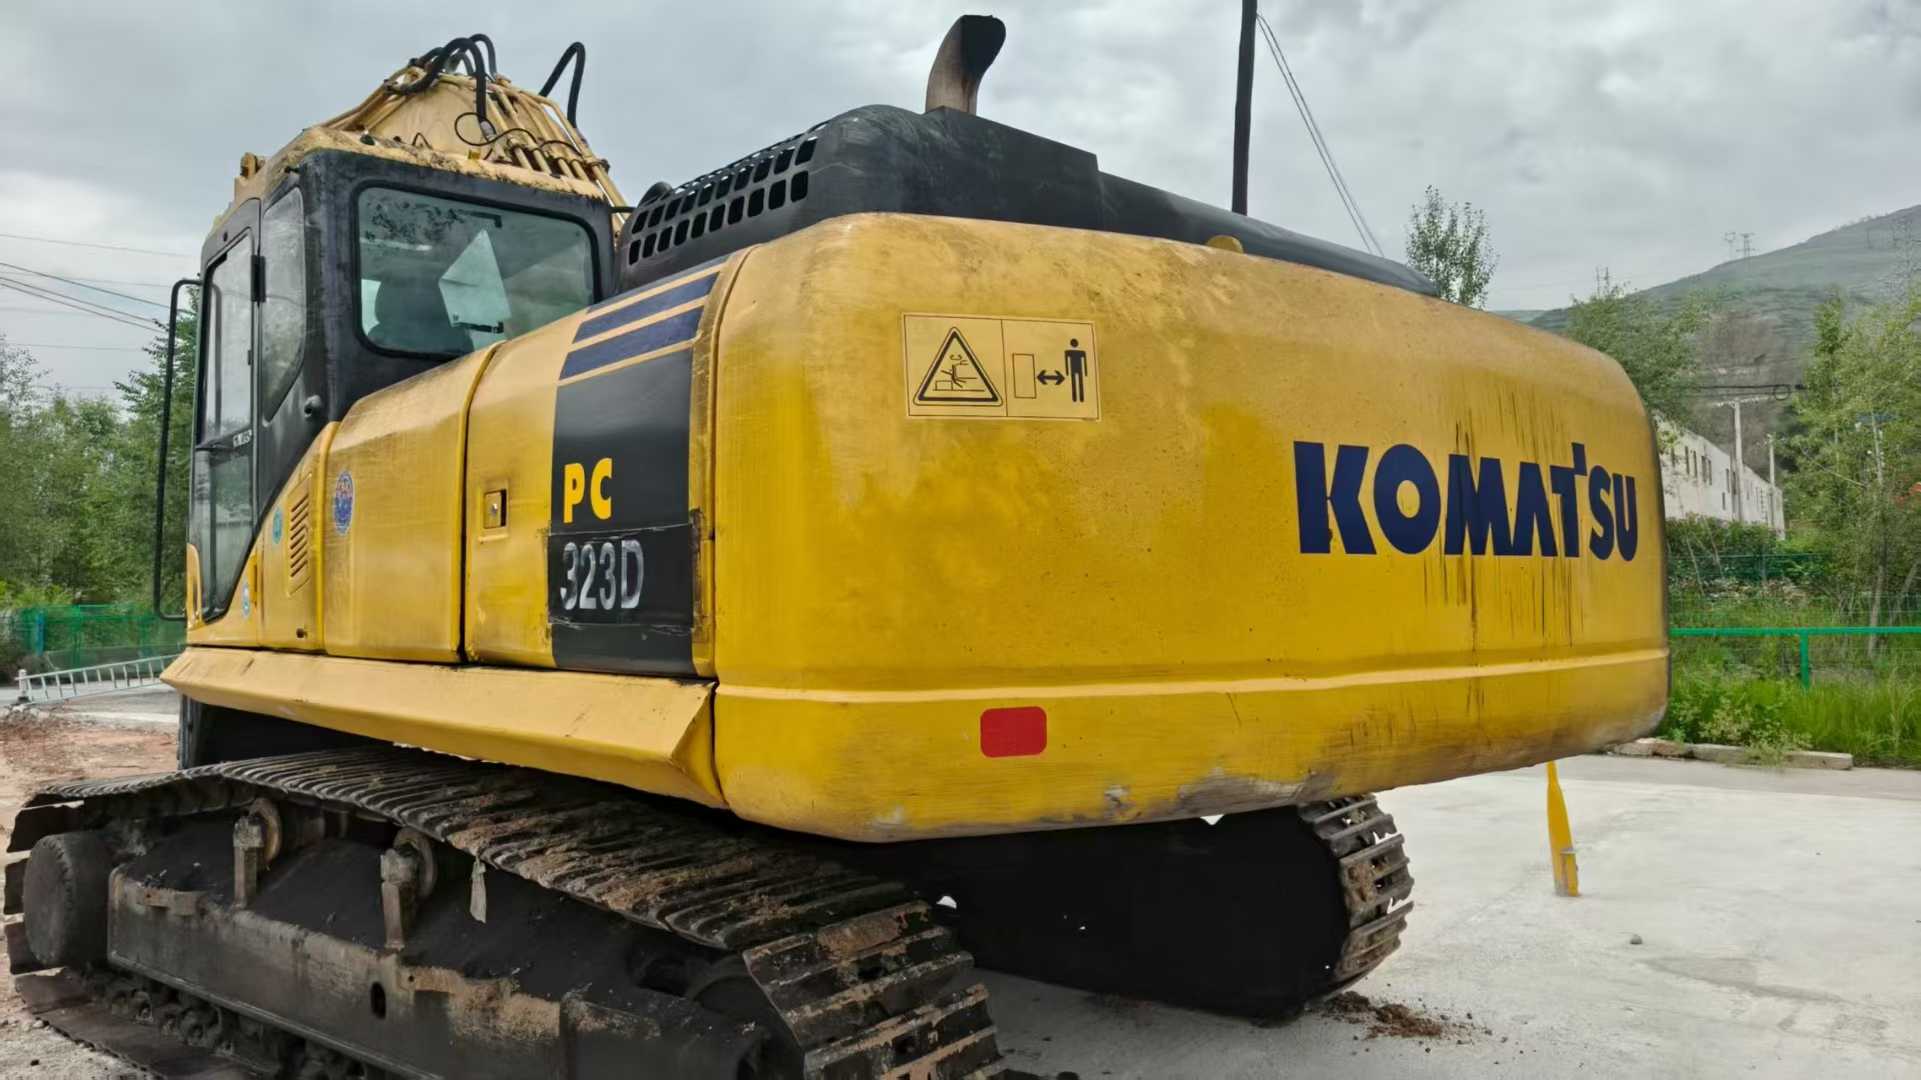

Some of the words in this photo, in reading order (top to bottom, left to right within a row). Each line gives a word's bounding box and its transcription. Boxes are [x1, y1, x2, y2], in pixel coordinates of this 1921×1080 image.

[563, 457, 613, 524] PC
[1293, 440, 1639, 562] KOMATSU
[560, 539, 645, 611] 323D
